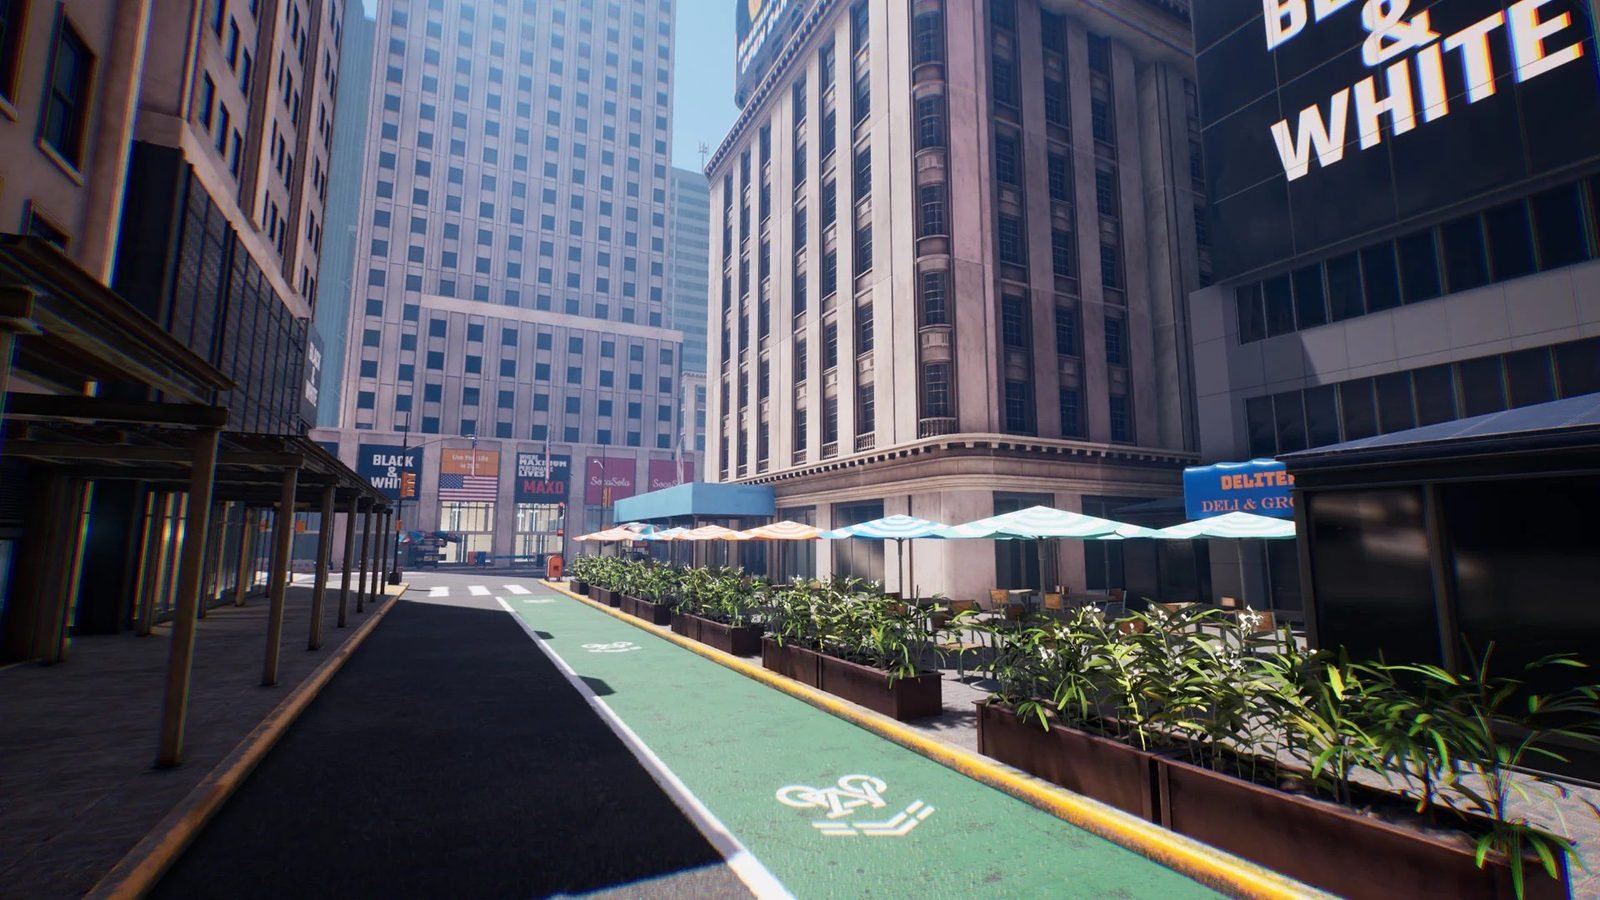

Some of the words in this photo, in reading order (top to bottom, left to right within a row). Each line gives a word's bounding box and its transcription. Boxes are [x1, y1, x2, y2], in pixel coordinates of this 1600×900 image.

[1361, 0, 1442, 68] &
[1270, 0, 1584, 182] WHITE
[373, 454, 414, 467] BLACK
[387, 466, 398, 478] &
[371, 477, 402, 489] WHI
[1202, 499, 1239, 513] DELI
[1243, 498, 1257, 510] &
